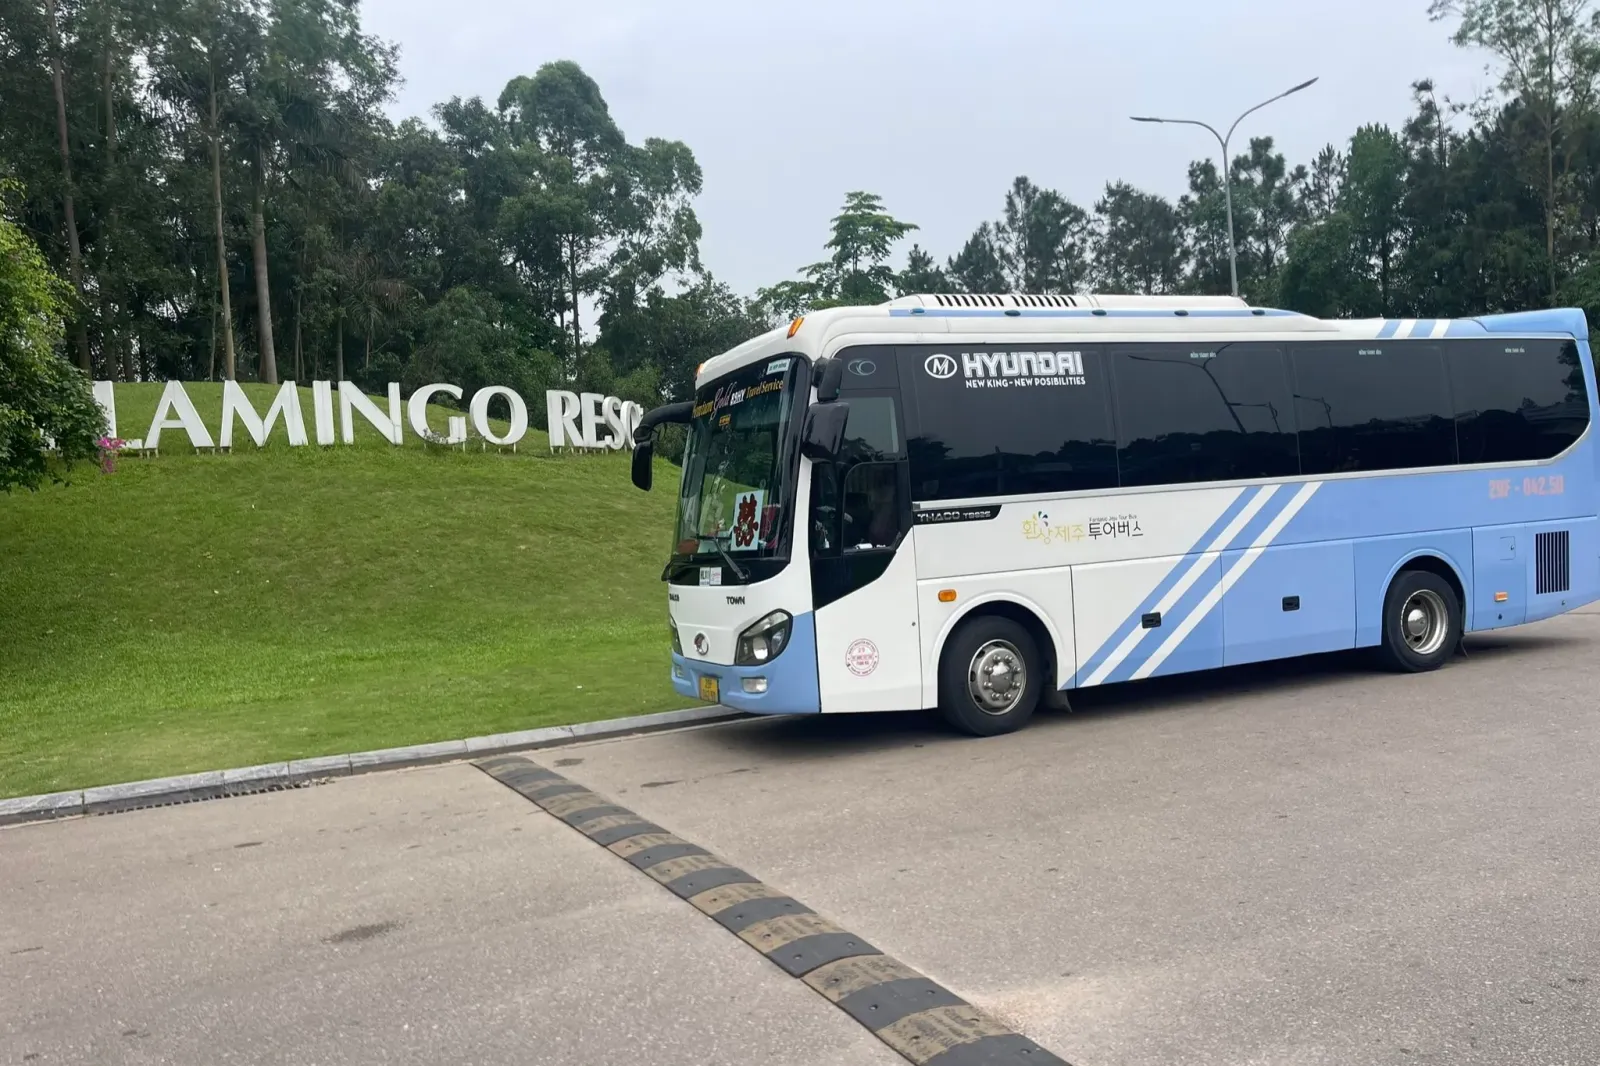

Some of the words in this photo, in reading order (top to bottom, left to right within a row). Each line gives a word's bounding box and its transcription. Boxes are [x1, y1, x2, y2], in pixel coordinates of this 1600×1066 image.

[961, 351, 1084, 377] HYUNDAI
[965, 380, 985, 389] NEW
[986, 379, 1008, 388] KING
[1014, 378, 1033, 387] NEW
[1034, 376, 1086, 386] POSIBILITIES
[41, 380, 529, 449] LAMINGO
[546, 390, 643, 450] RESO
[917, 511, 960, 522] THACO
[1088, 520, 1144, 541] 투어버스
[726, 596, 746, 605] TOWN
